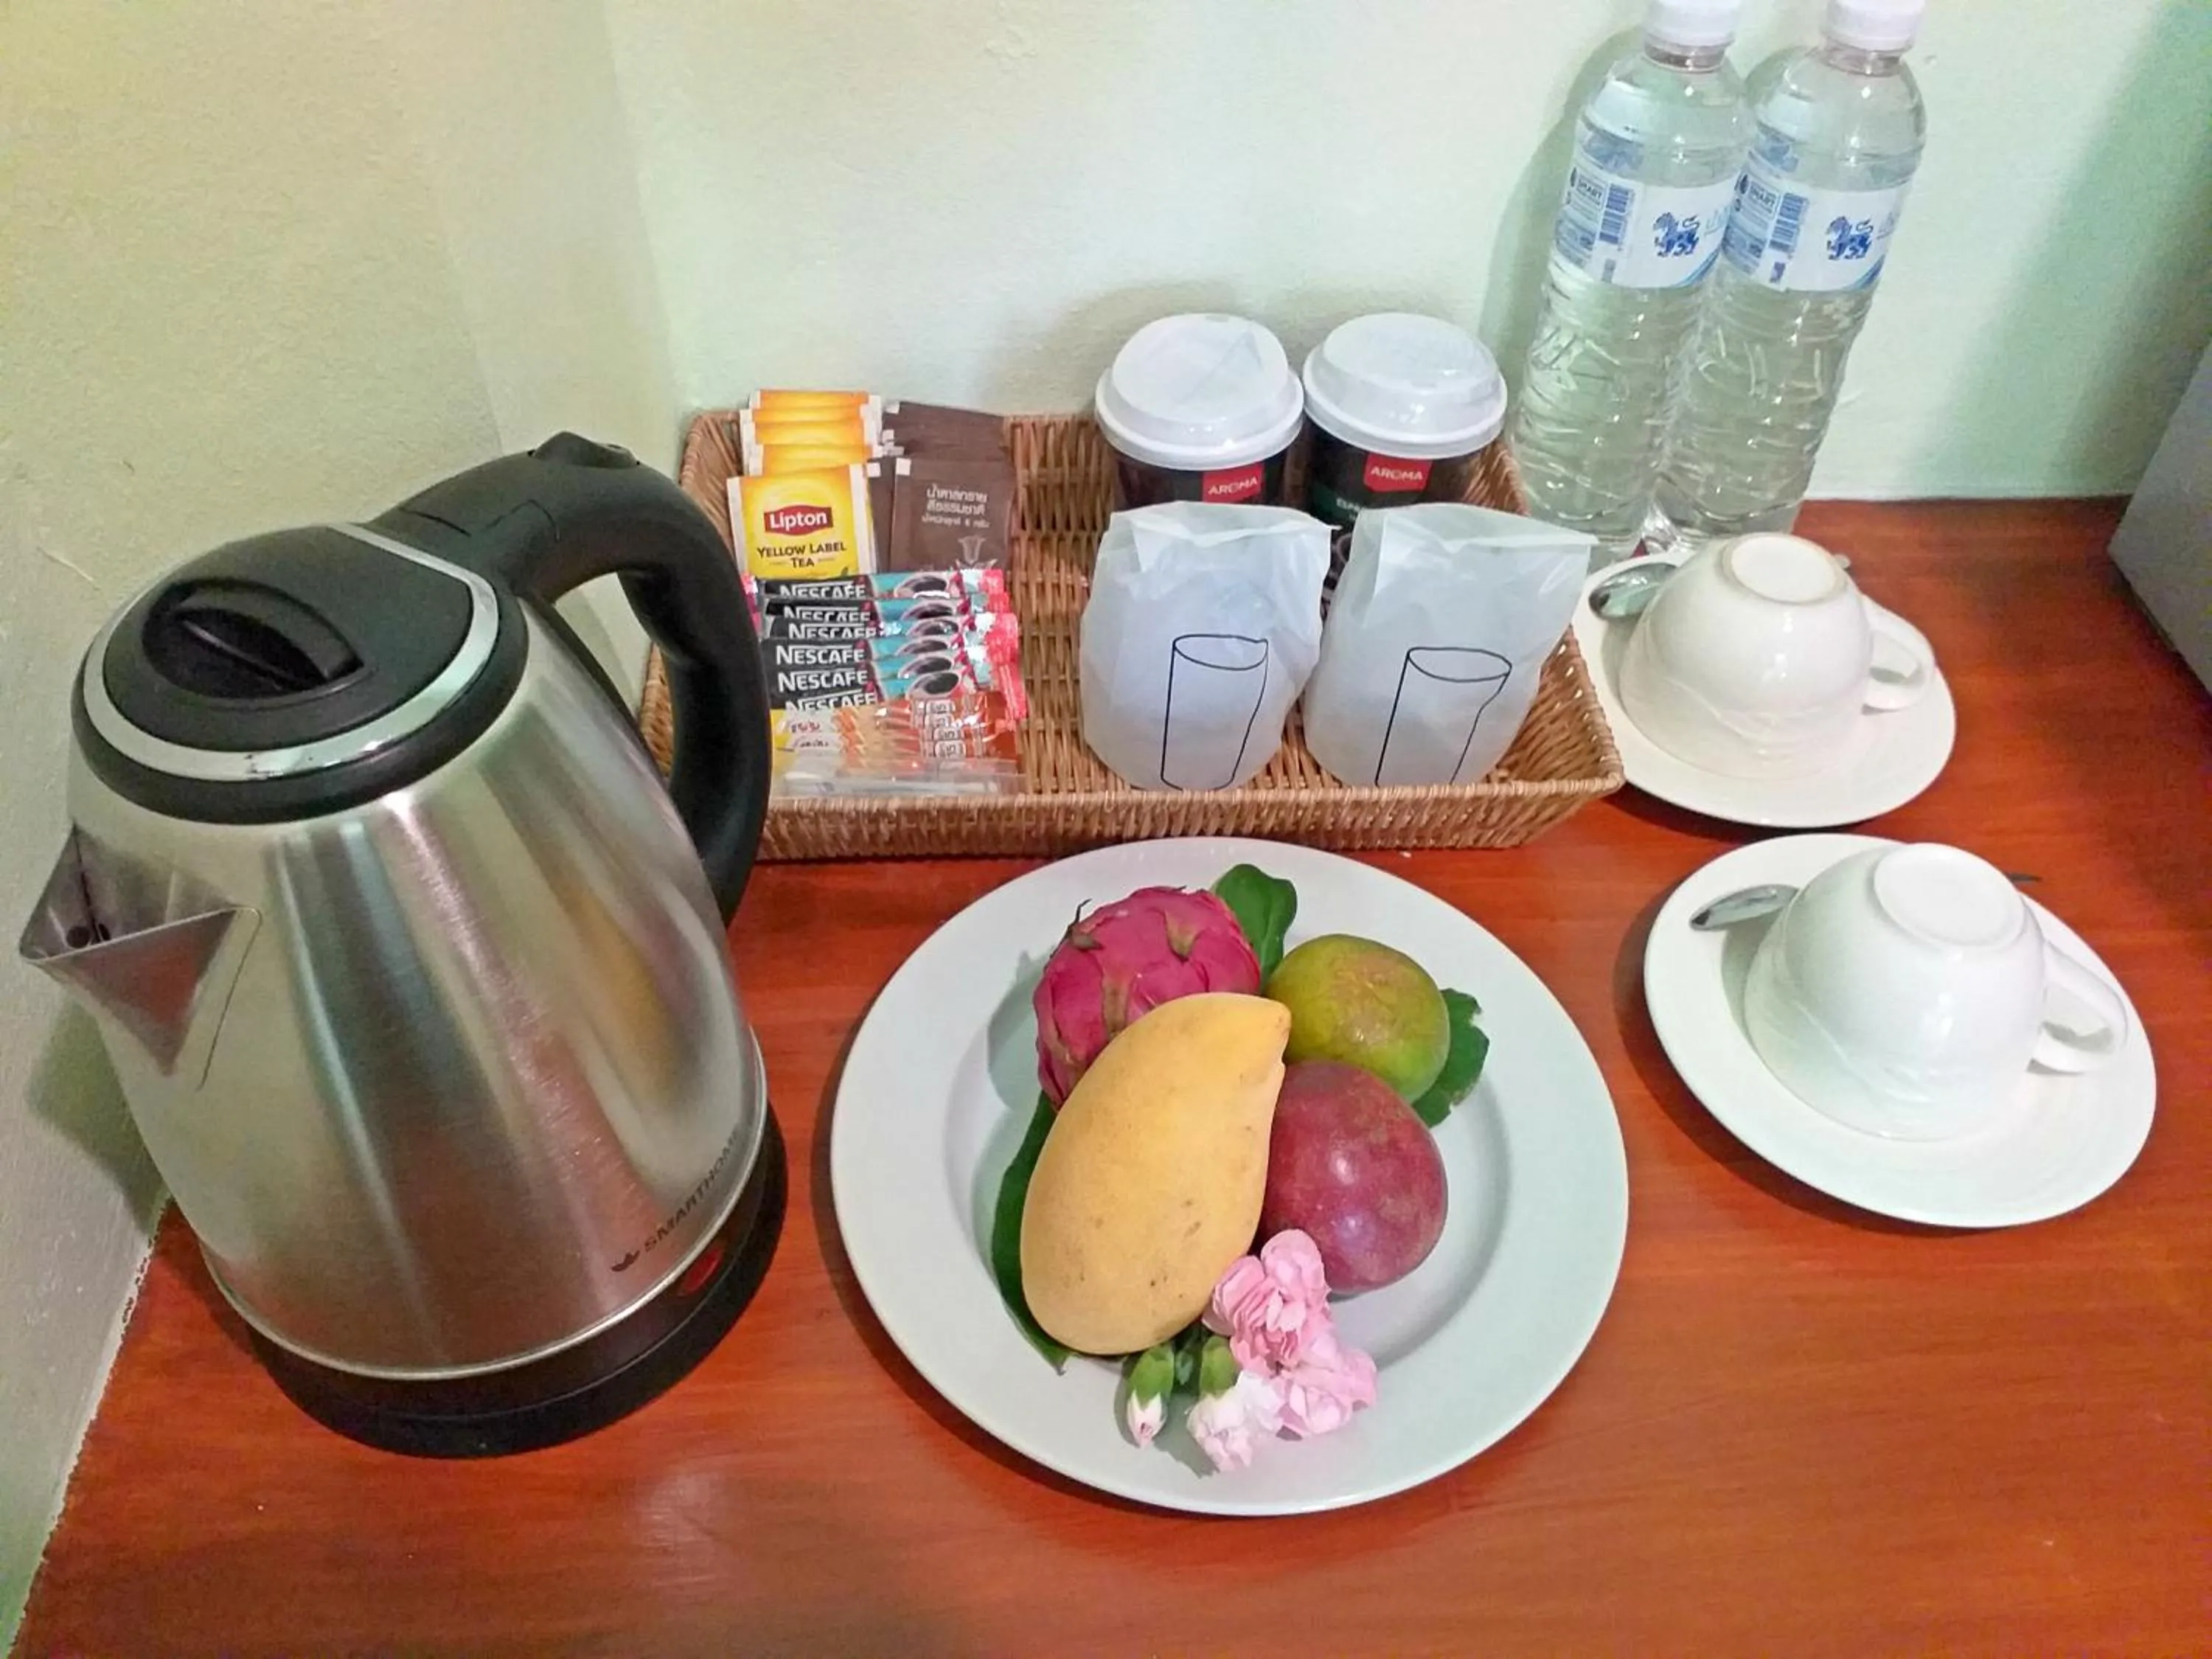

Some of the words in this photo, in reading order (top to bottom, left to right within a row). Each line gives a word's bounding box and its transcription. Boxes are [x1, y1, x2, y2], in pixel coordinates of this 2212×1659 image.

[1371, 465, 1423, 481] AROMA
[1208, 477, 1258, 495] AROMA
[770, 512, 827, 532] Lipton
[757, 544, 806, 558] YELLOW
[810, 542, 847, 554] LABEL
[790, 557, 815, 568] TEA
